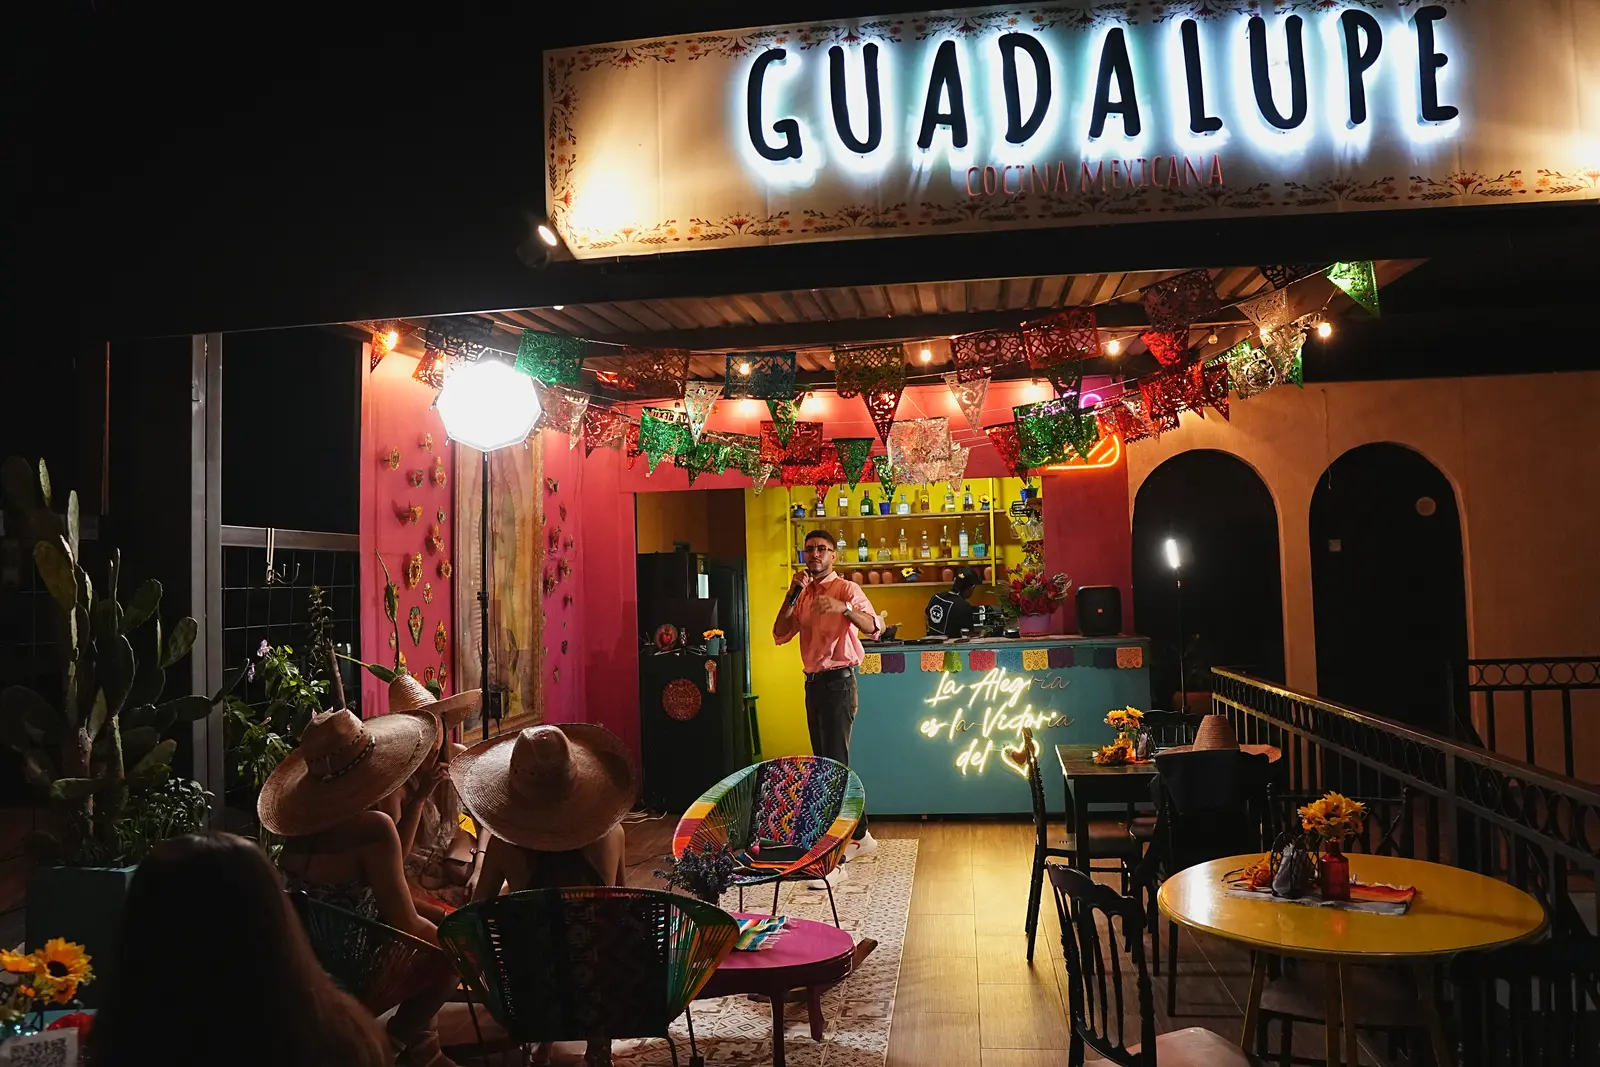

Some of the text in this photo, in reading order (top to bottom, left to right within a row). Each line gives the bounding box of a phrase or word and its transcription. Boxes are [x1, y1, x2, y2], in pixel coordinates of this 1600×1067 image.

[747, 5, 1459, 161] GUADALUPE
[965, 152, 1224, 198] COCINA MEXICANA
[923, 667, 1070, 708] La Alegría
[920, 702, 1075, 740] es la Victoria
[956, 738, 993, 776] del
